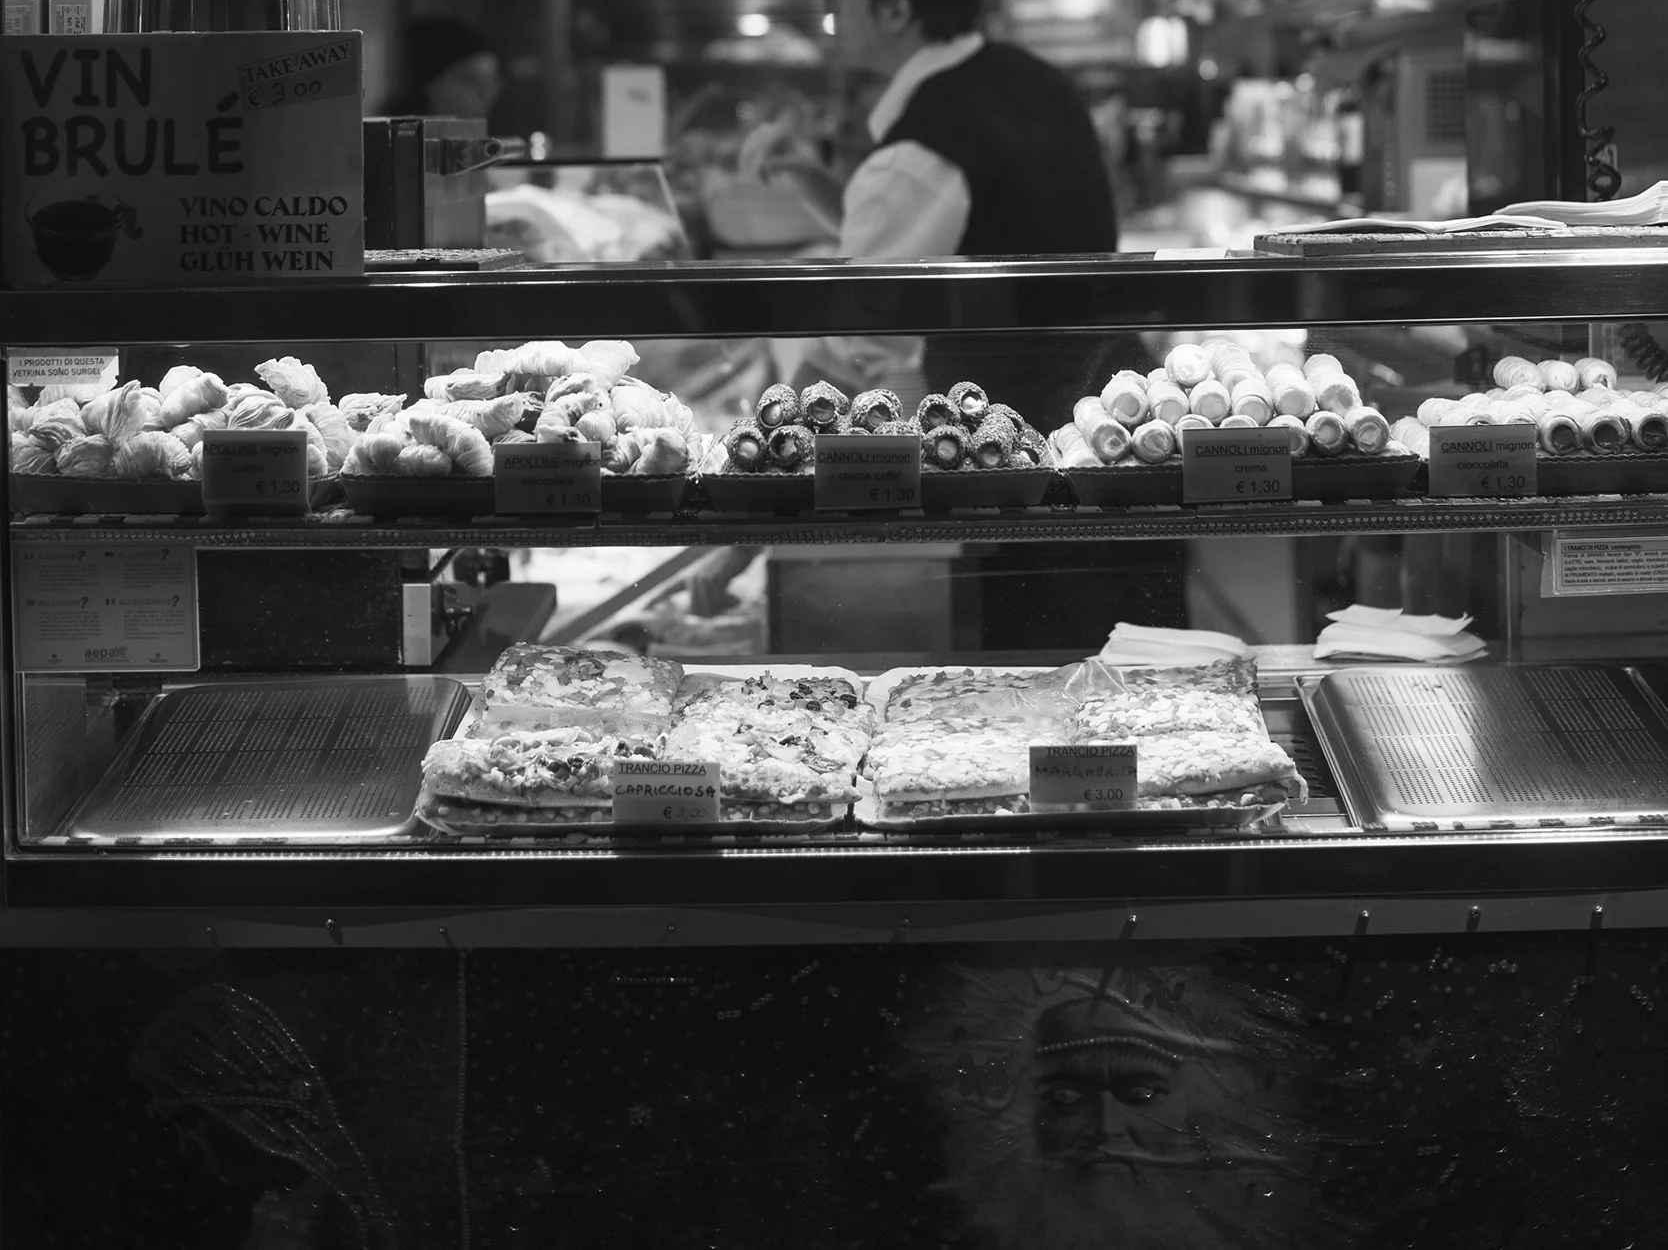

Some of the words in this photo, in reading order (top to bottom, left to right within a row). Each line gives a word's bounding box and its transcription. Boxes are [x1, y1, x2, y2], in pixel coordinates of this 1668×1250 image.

[243, 57, 295, 83] TAKE
[298, 42, 351, 71] AWAY
[21, 47, 152, 109] VIN
[247, 90, 262, 106] €
[21, 92, 245, 177] BRULÉ
[179, 196, 247, 217] VINO
[254, 196, 348, 217] CALDO
[180, 223, 237, 244] HOT
[257, 222, 331, 244] WINE
[180, 247, 254, 271] GLÜH
[261, 249, 334, 271] WEIN
[24, 359, 62, 367] PRODOTTI
[64, 358, 73, 366] DI
[74, 357, 104, 366] QUESTA
[12, 369, 46, 377] VETRINA
[48, 368, 69, 376] SONO
[71, 367, 101, 375] SURGEL
[261, 445, 299, 457] mignon
[1195, 445, 1247, 457] CANNOLI
[1250, 444, 1289, 456] mignon
[1440, 441, 1493, 453] CANNOLI
[1496, 440, 1534, 452] mignon
[504, 457, 560, 469] APOLLINE
[817, 452, 869, 464] CANNOLI
[872, 453, 911, 465] mignon
[1457, 460, 1509, 470] cioccolata
[1234, 463, 1268, 473] crema
[838, 472, 871, 481] crema
[1481, 476, 1491, 489] €
[257, 480, 266, 494] €
[1236, 480, 1245, 494] €
[546, 493, 556, 507] €
[869, 488, 880, 501] €
[1046, 747, 1098, 758] TRANCIO
[1101, 746, 1135, 757] PIZZA
[619, 763, 671, 775] TRANCIO
[673, 763, 707, 775] PIZZA
[615, 784, 716, 798] CAPRICCIOSA
[1083, 788, 1092, 801] €
[664, 806, 672, 819] €
